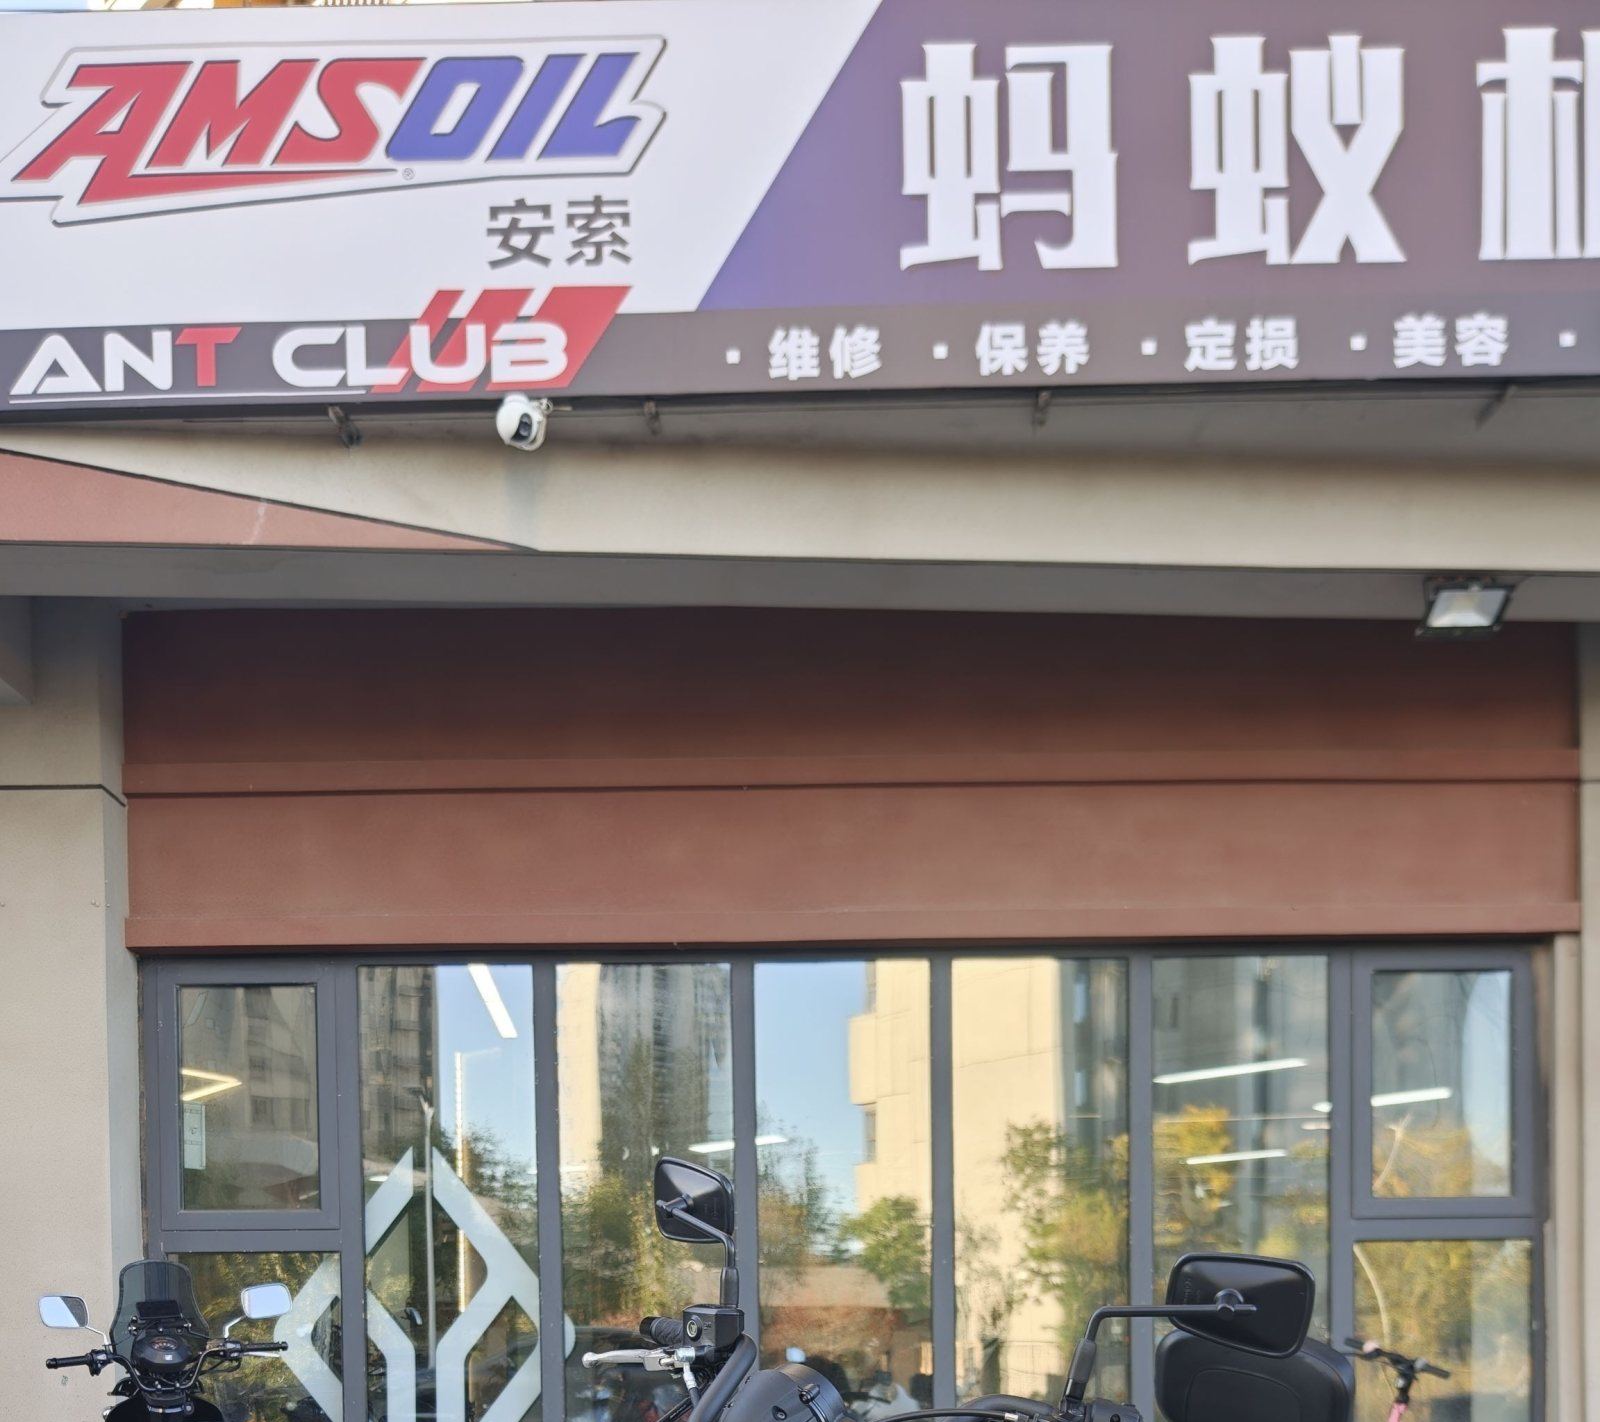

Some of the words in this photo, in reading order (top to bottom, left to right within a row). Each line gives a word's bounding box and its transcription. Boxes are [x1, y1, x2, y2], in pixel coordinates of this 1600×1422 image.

[12, 52, 641, 204] AMSOIL
[486, 195, 632, 270] 安索
[11, 326, 241, 395] ANT
[272, 322, 569, 392] CLUB
[767, 325, 882, 380] 维修
[975, 320, 1090, 376] 保养
[1184, 316, 1299, 371] 定损
[1393, 312, 1508, 367] 美容
